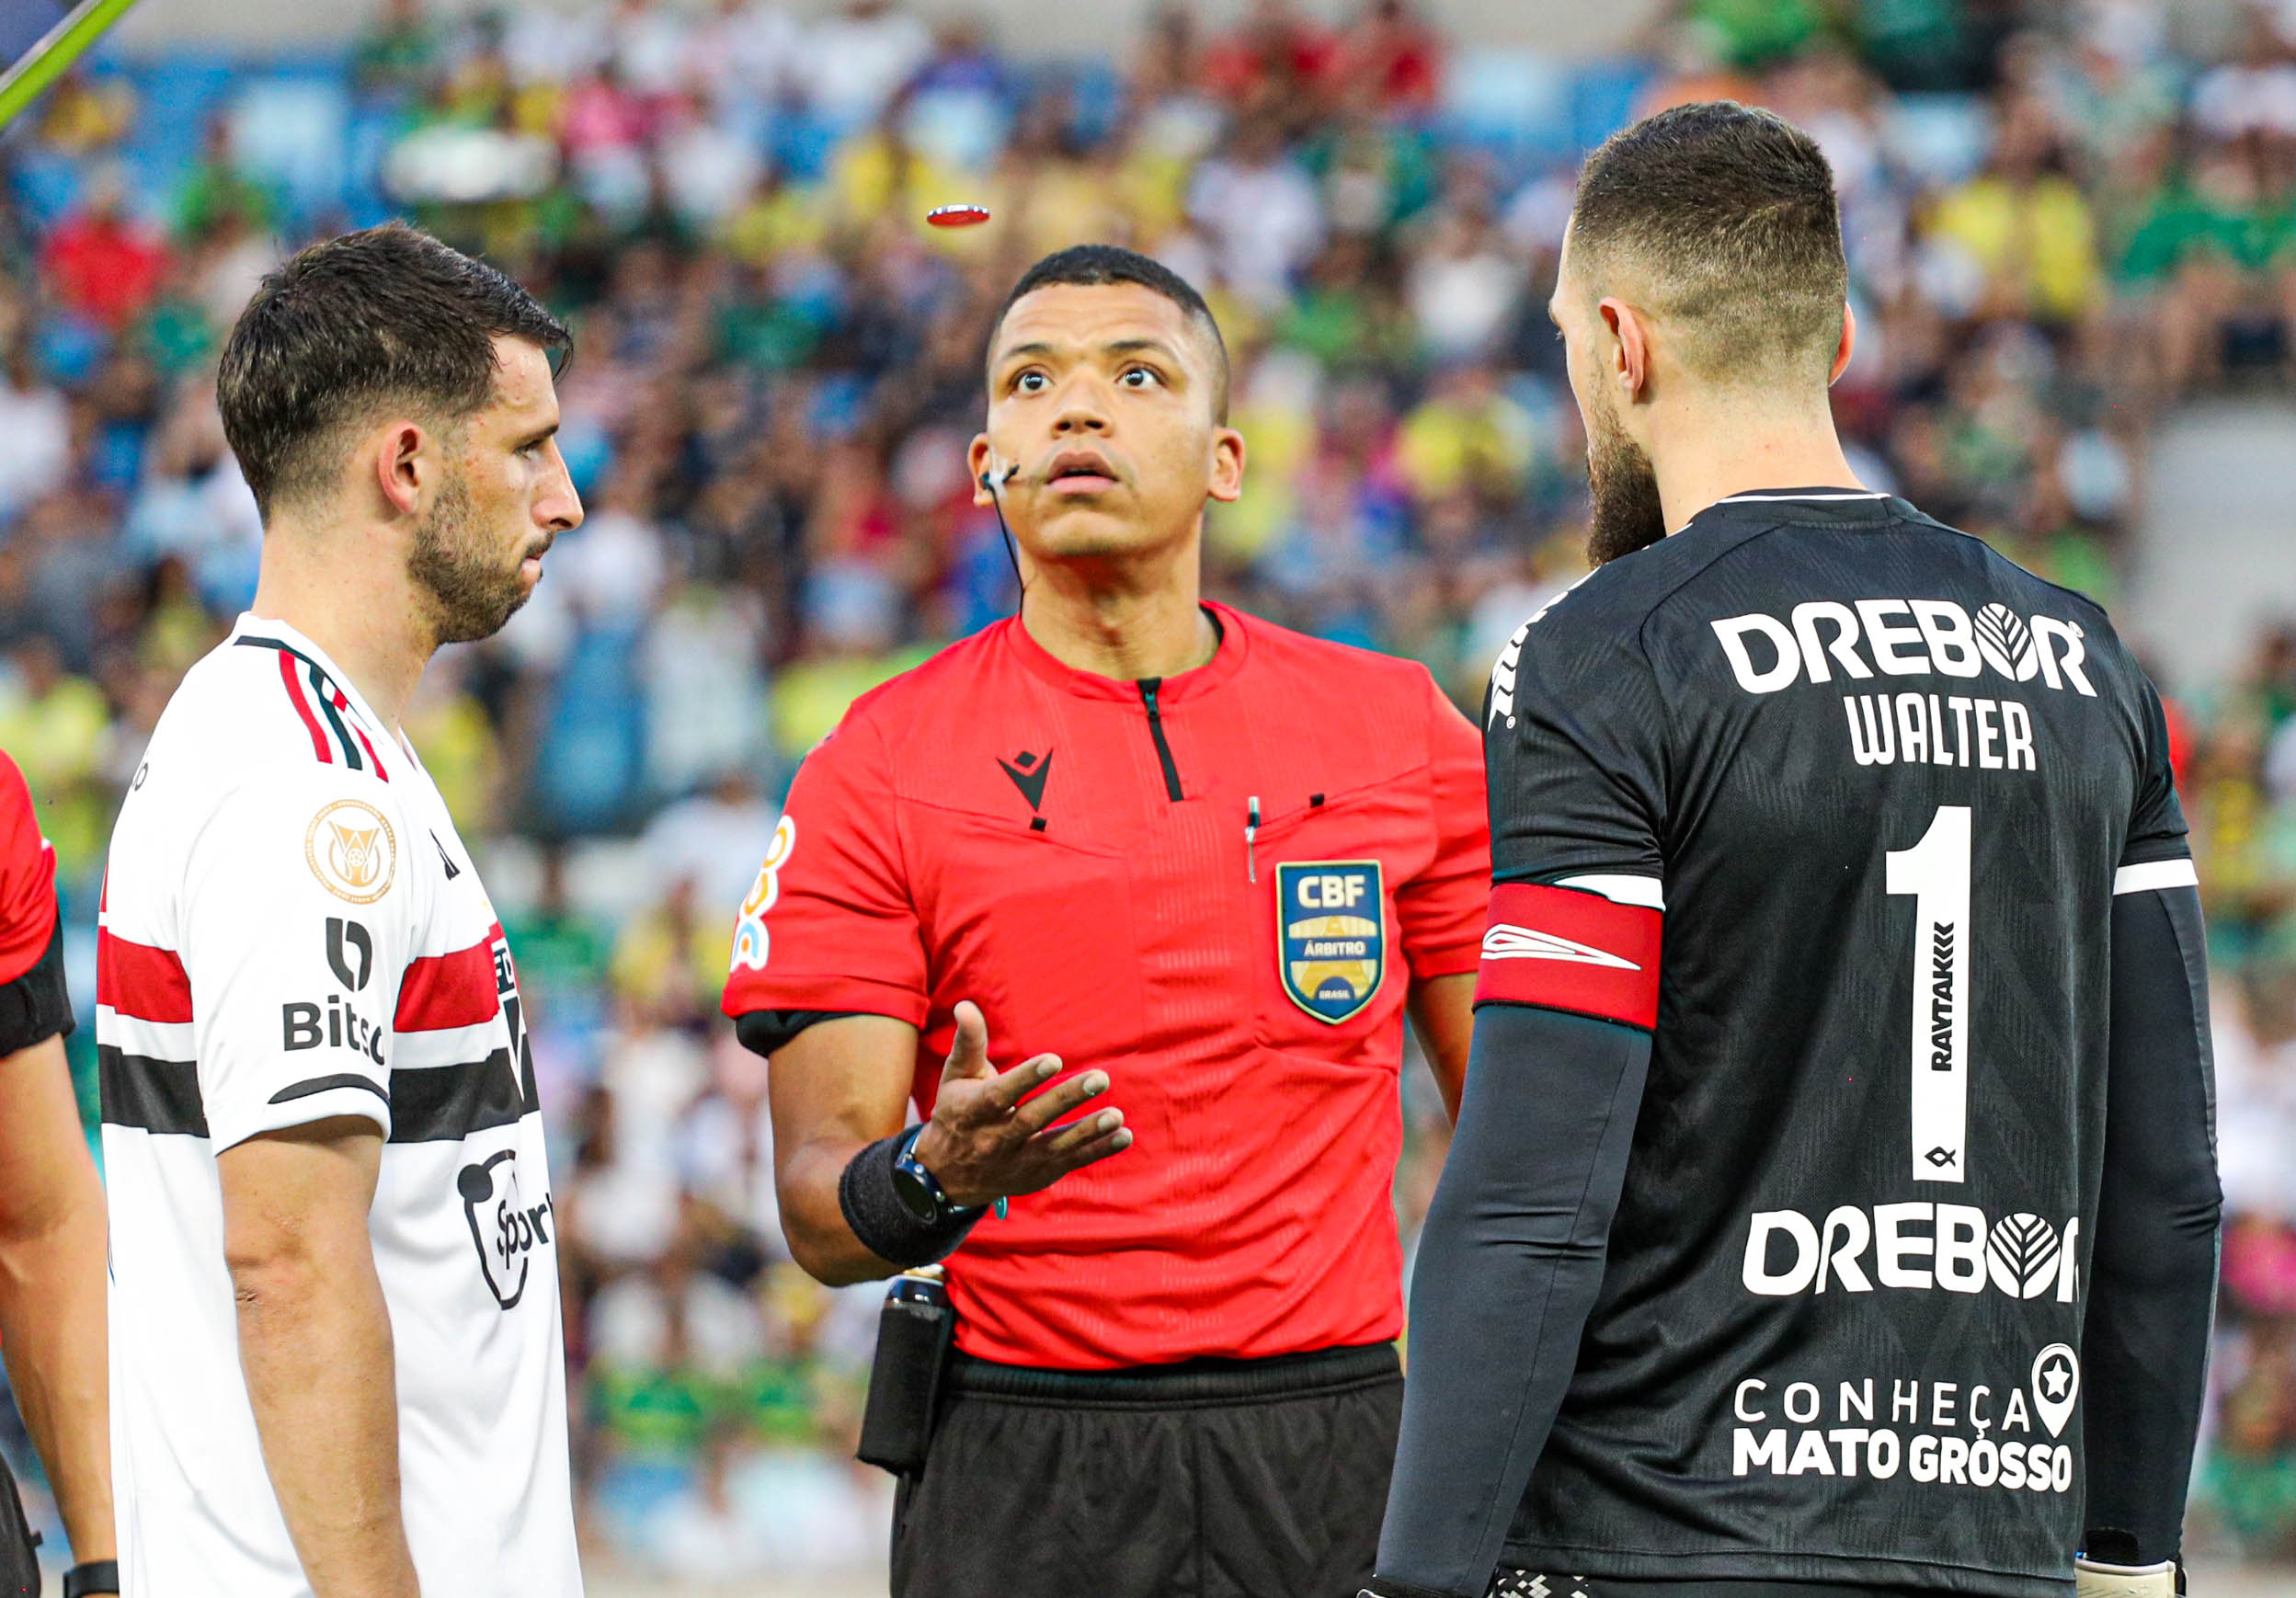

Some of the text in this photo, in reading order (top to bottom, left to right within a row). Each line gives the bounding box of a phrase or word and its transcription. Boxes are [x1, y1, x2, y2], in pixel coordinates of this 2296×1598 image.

[1710, 599, 2097, 697] DREBOR
[1844, 692, 2037, 771] WALTER
[1297, 874, 1365, 908] CBF
[1304, 940, 1365, 956] ÁRBITRO
[1885, 805, 1971, 1183] 1
[1931, 956, 1953, 1071] RAYTAK
[1734, 1378, 2030, 1438] CONHEÇA
[1732, 1428, 2072, 1493] MATO GROSSO
